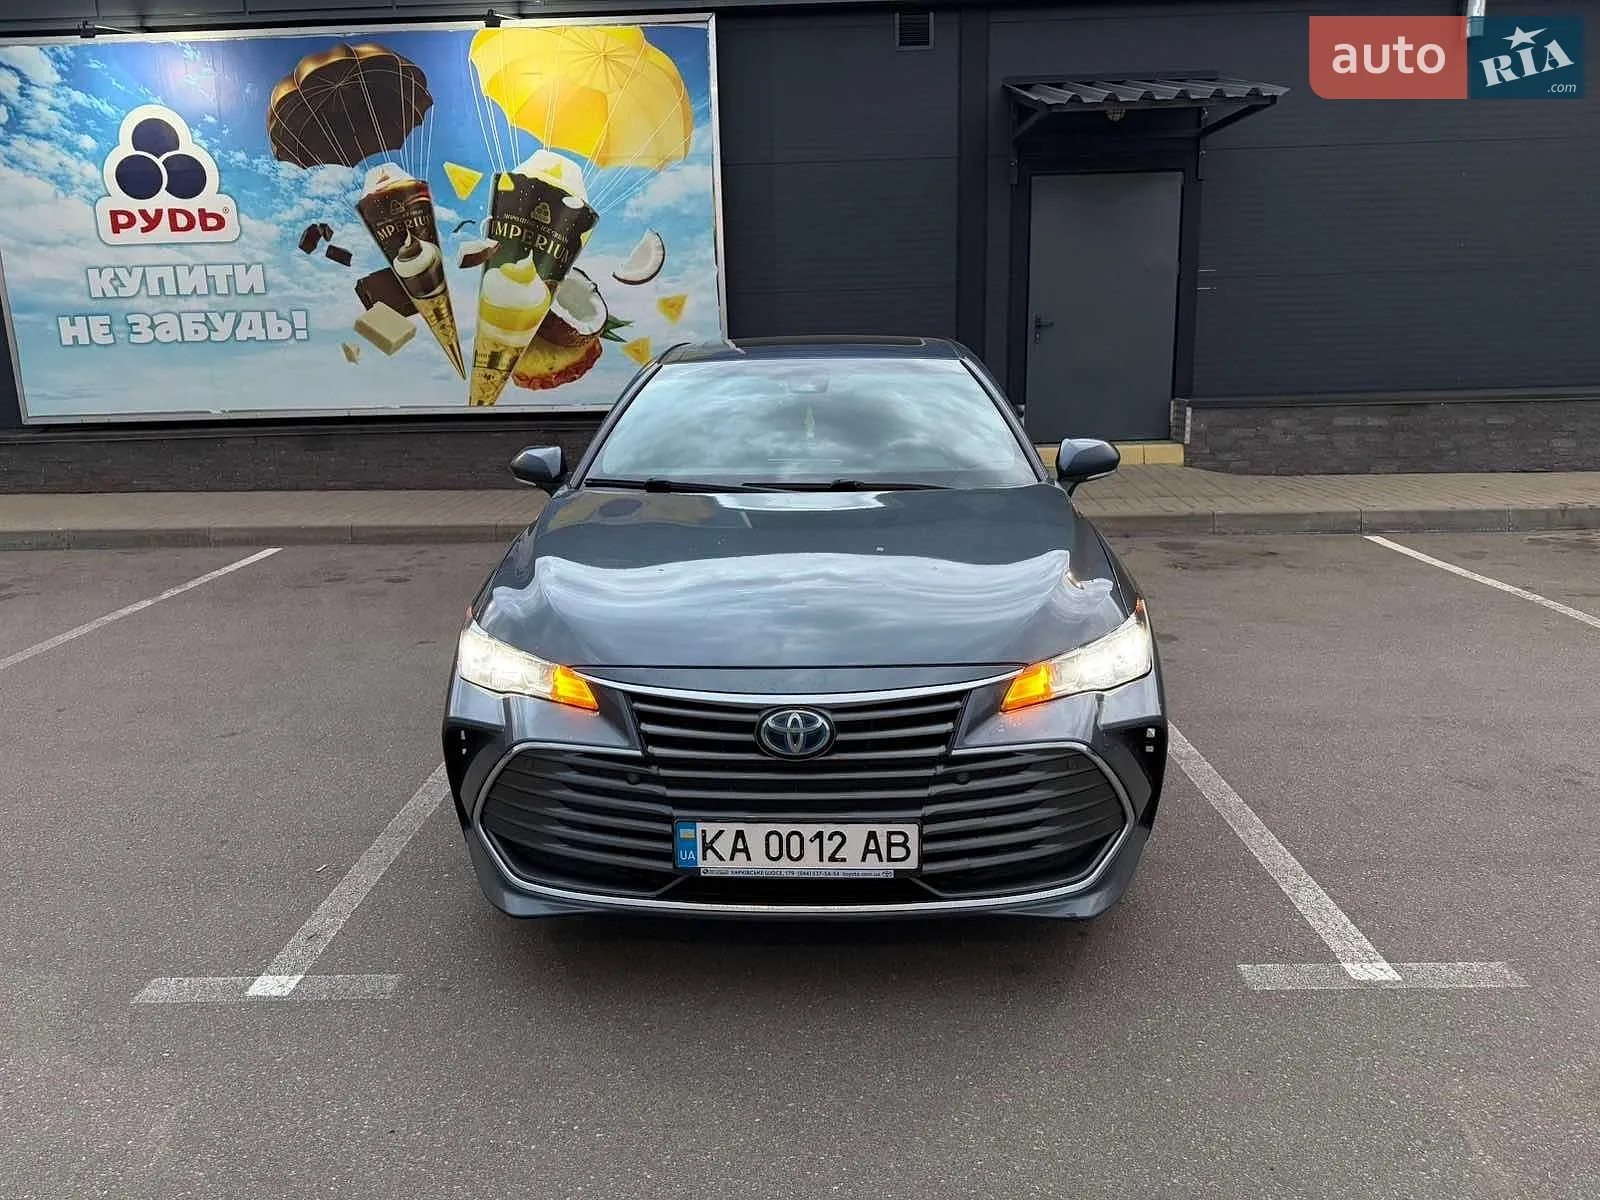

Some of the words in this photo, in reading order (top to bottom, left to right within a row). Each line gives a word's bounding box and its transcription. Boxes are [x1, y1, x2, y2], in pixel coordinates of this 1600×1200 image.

[109, 208, 226, 234] РУДЬ
[87, 264, 267, 299] КУПИТИ
[58, 315, 115, 345] НЕ
[680, 849, 696, 861] UA
[701, 829, 752, 862] KA
[764, 830, 847, 862] 0012
[860, 830, 912, 863] AB
